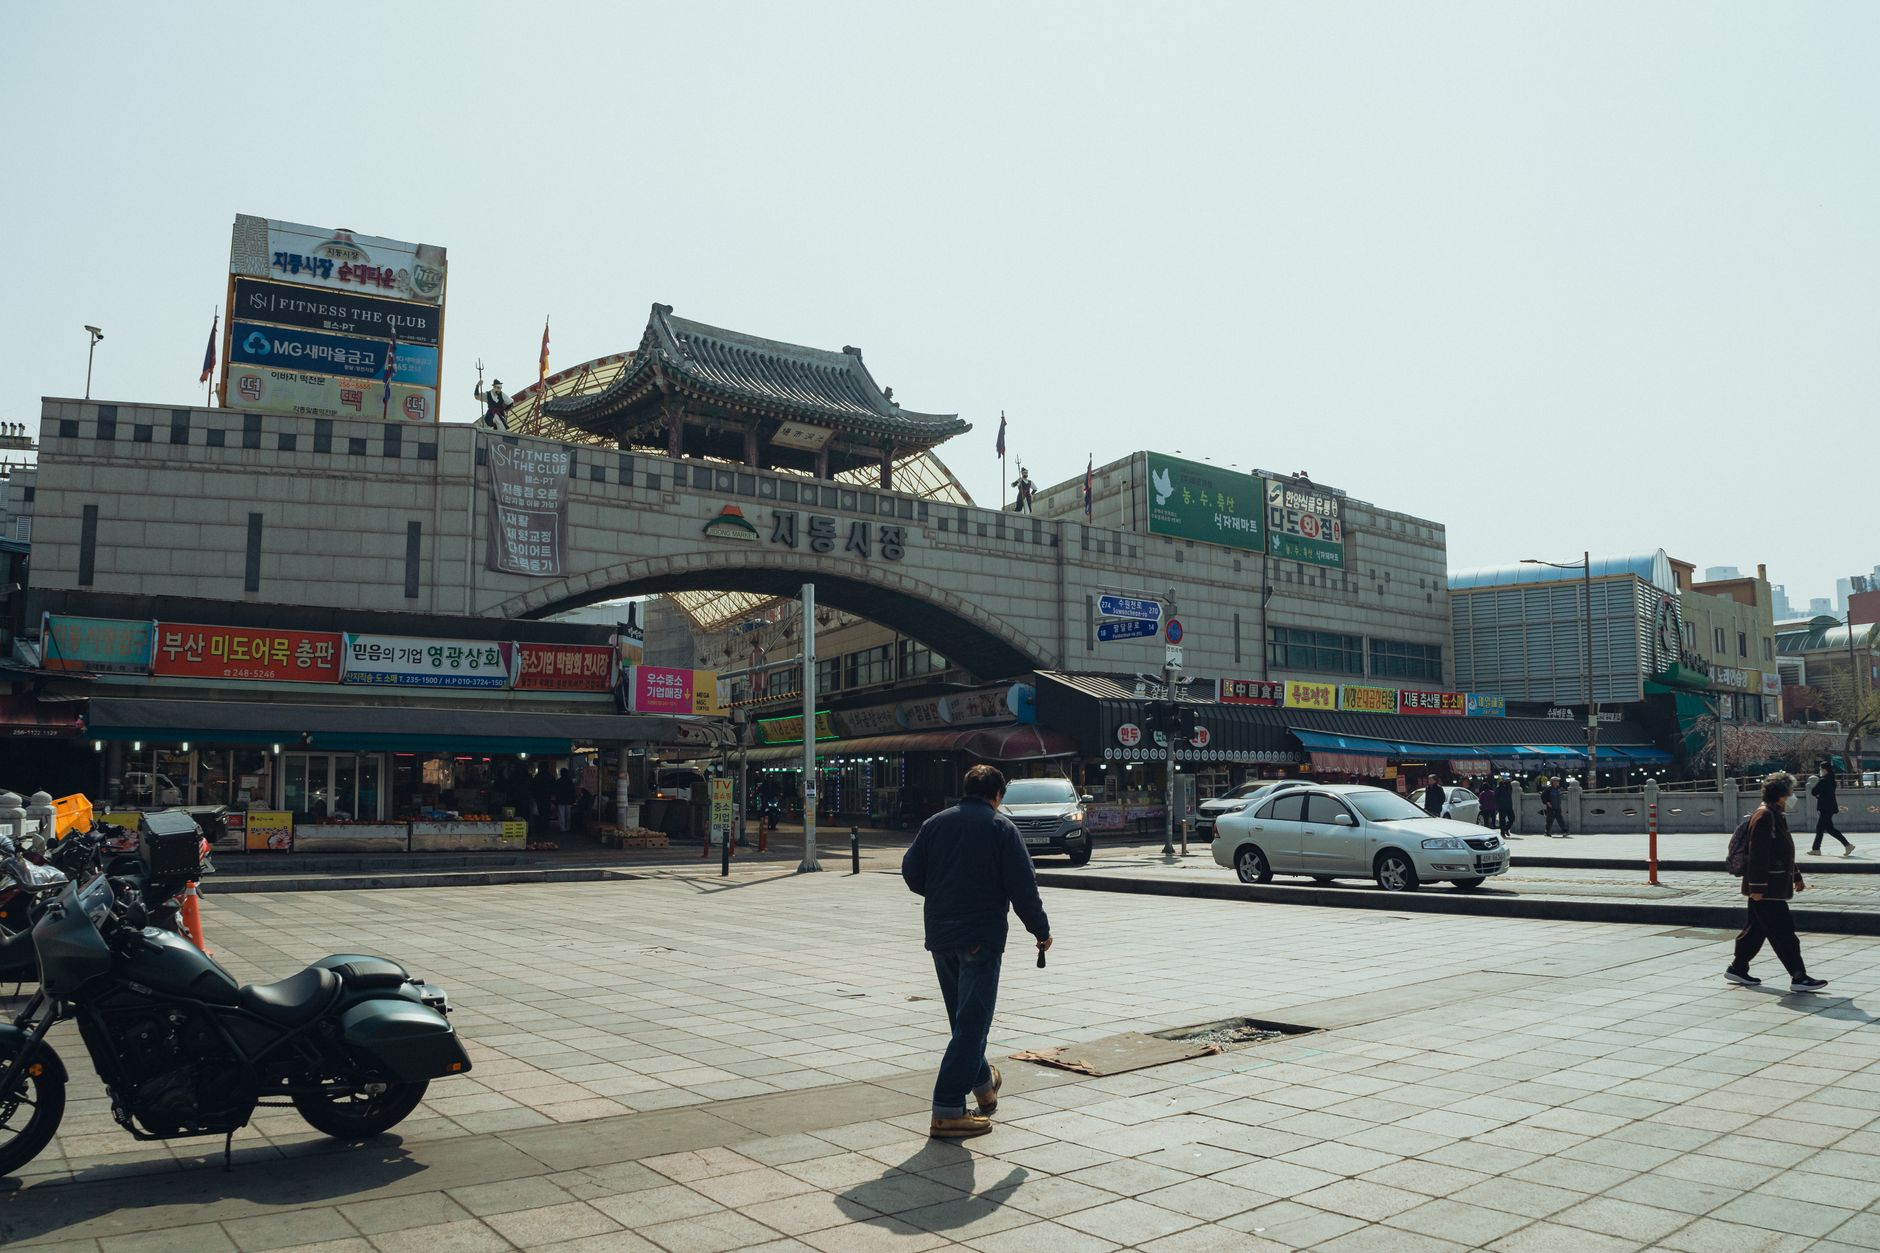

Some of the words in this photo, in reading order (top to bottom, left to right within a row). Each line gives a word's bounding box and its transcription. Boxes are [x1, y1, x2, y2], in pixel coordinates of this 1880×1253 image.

[272, 251, 335, 280] 지동시장
[338, 260, 396, 289] 순대타운
[279, 298, 347, 318] FITNESS
[351, 308, 382, 323] THE
[386, 313, 426, 329] CLUB
[240, 375, 262, 401] 떡
[340, 388, 362, 413] 떡
[407, 395, 426, 419] 떡
[513, 448, 568, 463] FITNESS
[513, 460, 535, 473] THE
[537, 463, 567, 475] CLUB
[502, 482, 534, 498] 지동점
[537, 488, 559, 500] 오픈
[1286, 490, 1331, 516] 한양식품유통
[506, 512, 529, 528] 재활
[1214, 512, 1257, 533] 식자재마트
[1271, 506, 1332, 541] 다도회집
[507, 527, 552, 543] 체형교정
[732, 529, 755, 539] MARKET
[771, 510, 907, 561] 지동시장
[508, 541, 552, 557] 다이어트
[508, 555, 553, 571] 근력증가
[1101, 601, 1112, 609] 274
[1118, 599, 1143, 610] 수원천로
[1148, 607, 1159, 615] 270
[162, 632, 205, 663] 부산
[210, 634, 291, 666] 미도어묵
[294, 640, 334, 669] 총판
[352, 643, 395, 662] 믿음의
[399, 648, 422, 664] 기업
[427, 646, 500, 669] 영광상회
[521, 650, 555, 675] 중소기업
[556, 651, 583, 675] 박람회
[583, 653, 609, 677] 전시장
[233, 668, 275, 679] 248-5246
[347, 672, 373, 684] 산지직송
[384, 673, 398, 684] 소매
[406, 675, 437, 685] 235-1500
[647, 673, 683, 687] 우수중소
[1717, 667, 1748, 688] 노래연습장
[647, 686, 683, 700] 기업매장
[1403, 691, 1418, 708] 지동
[1420, 692, 1441, 708] 축산물
[1121, 727, 1138, 742] 만두
[713, 780, 731, 790] TV
[713, 792, 731, 801] 홈쇼핑
[714, 802, 730, 812] 중소
[713, 813, 730, 823] 기업
